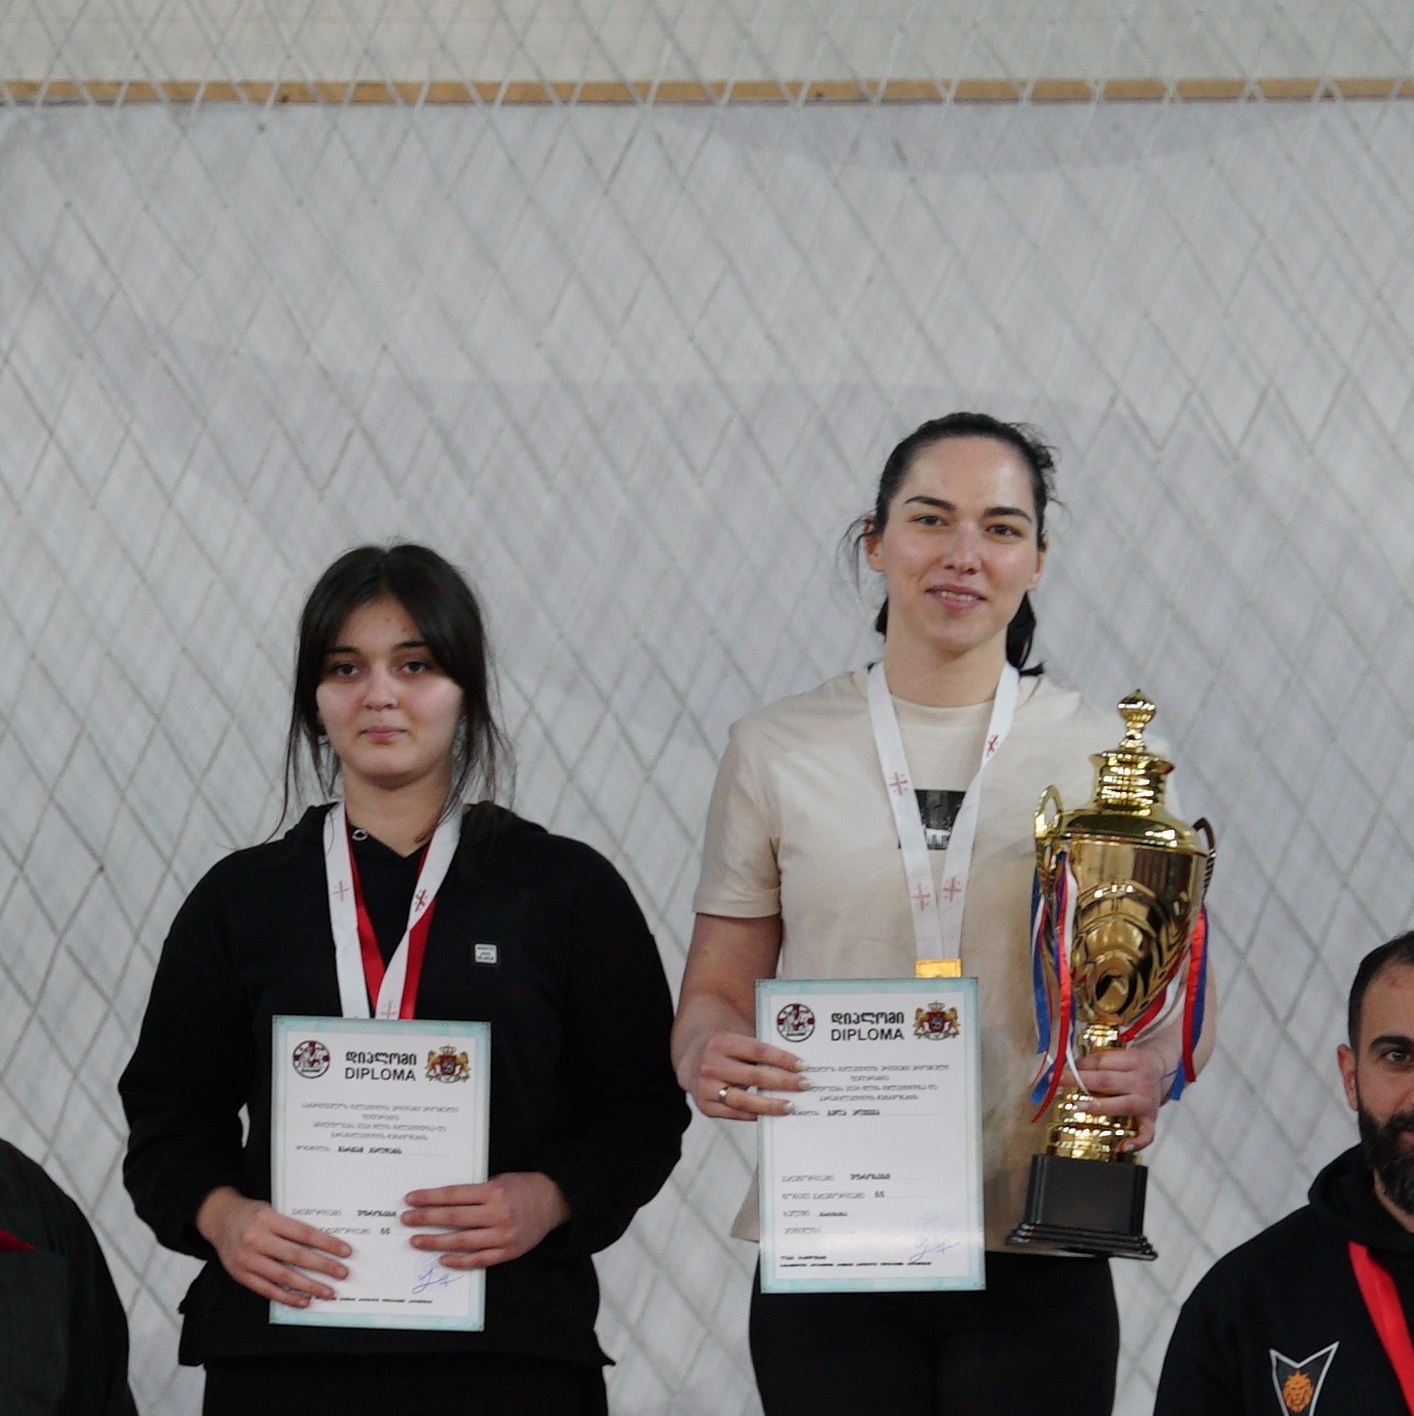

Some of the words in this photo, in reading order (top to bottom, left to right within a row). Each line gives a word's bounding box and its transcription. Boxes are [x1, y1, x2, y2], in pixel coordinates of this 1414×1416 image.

[830, 1011, 905, 1026] დიპლომი
[830, 1028, 905, 1041] DIPLOMA
[345, 1051, 418, 1066] დიპლომი
[344, 1067, 417, 1082] DIPLOMA
